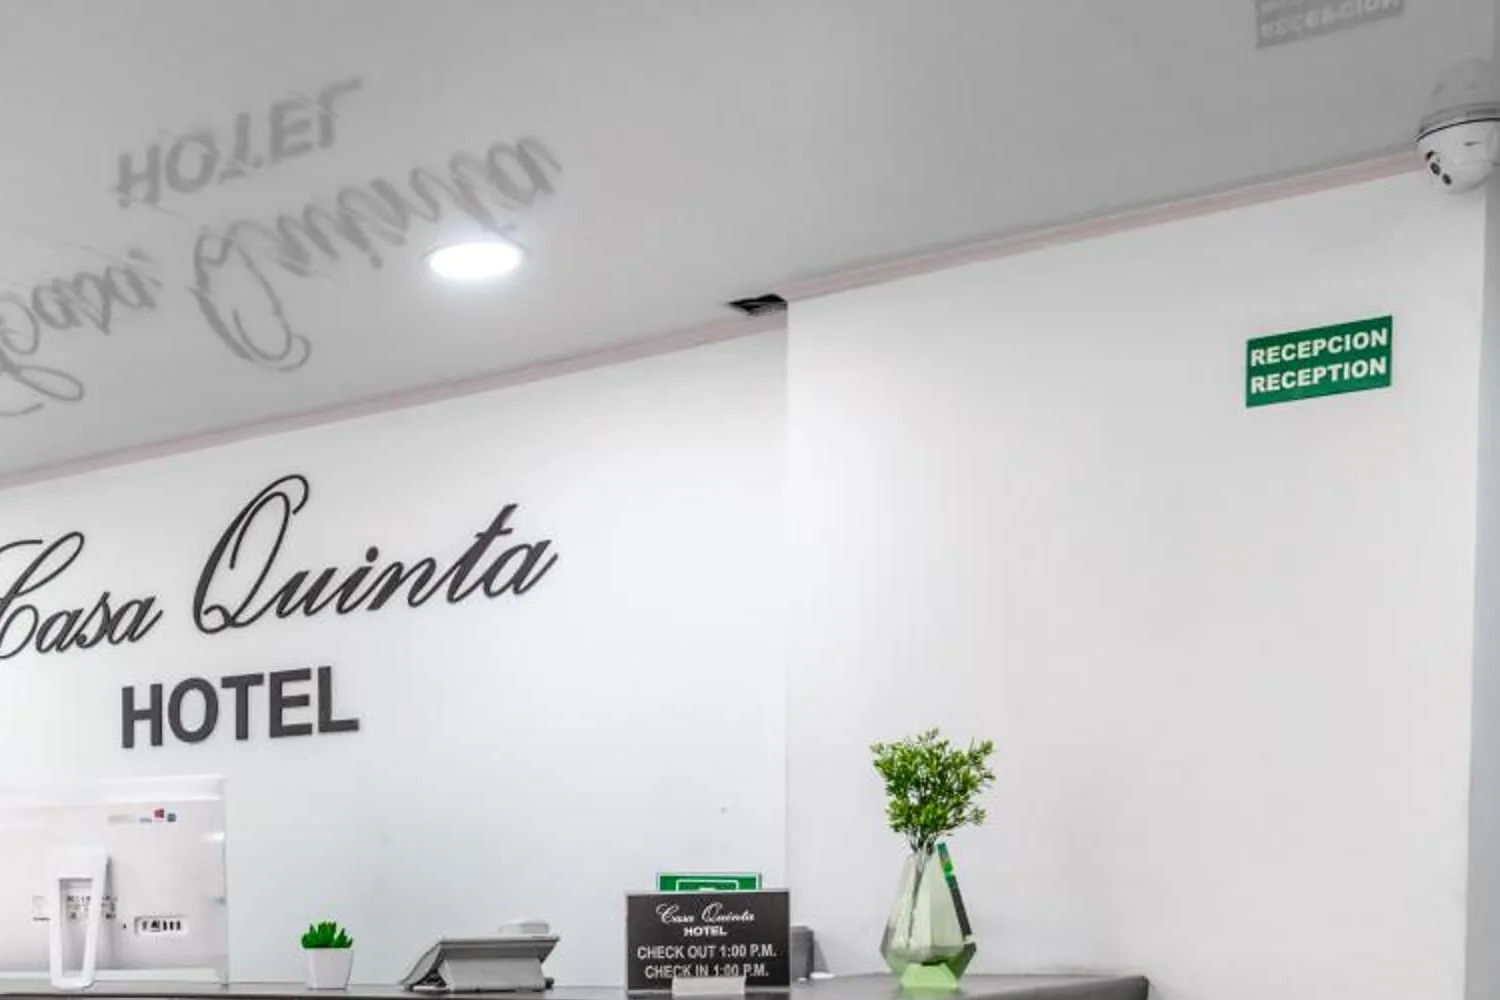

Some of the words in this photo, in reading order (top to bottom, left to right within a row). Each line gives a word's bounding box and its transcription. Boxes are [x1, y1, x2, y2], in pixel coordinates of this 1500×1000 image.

[1251, 327, 1388, 367] RECEPCION
[1251, 356, 1387, 394] RECEPTION
[192, 474, 559, 635] Quinta
[121, 666, 360, 749] HOTEL
[656, 902, 695, 925] Casa
[701, 901, 755, 924] Quinta
[683, 925, 728, 937] HOTEL
[637, 945, 685, 960] CHECK
[687, 944, 717, 959] OUT
[720, 943, 747, 958] 1:00
[750, 943, 777, 957] P.M.
[644, 964, 692, 979] CHECK
[695, 964, 709, 977] IN
[713, 963, 739, 977] 1:00
[743, 963, 769, 977] P.M.
